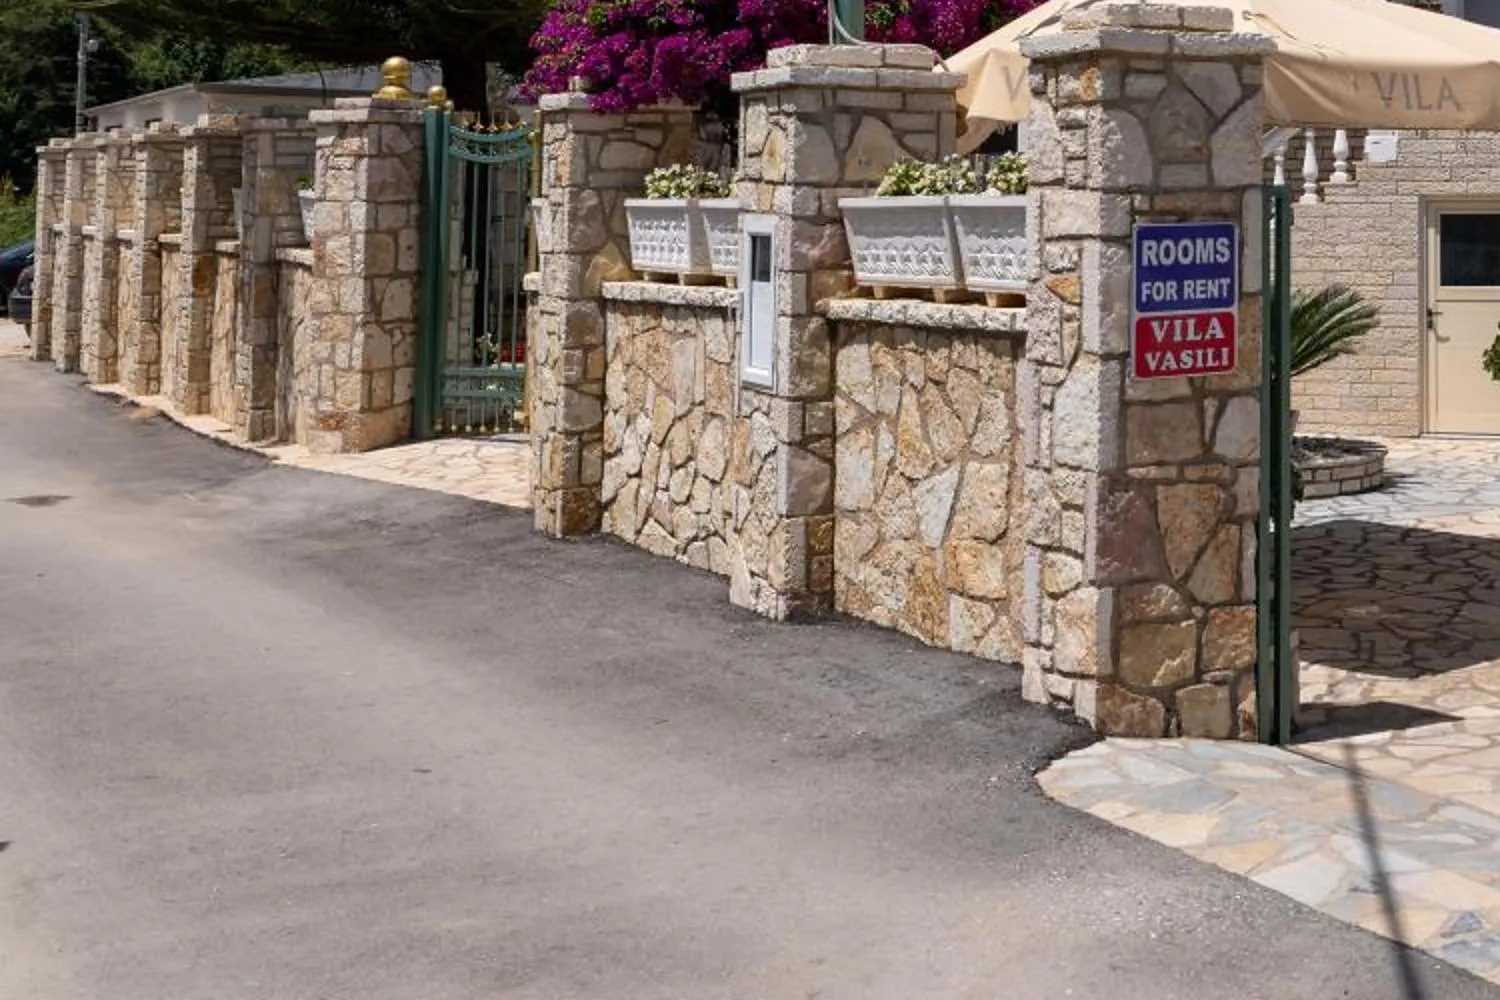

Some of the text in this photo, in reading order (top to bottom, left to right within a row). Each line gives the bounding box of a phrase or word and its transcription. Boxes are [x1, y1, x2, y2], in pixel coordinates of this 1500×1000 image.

[1369, 71, 1463, 112] VILA
[1141, 237, 1231, 267] ROOMS
[1141, 277, 1231, 303] FOR RENT
[1151, 316, 1225, 343] VILA
[1144, 347, 1229, 372] VASILI
